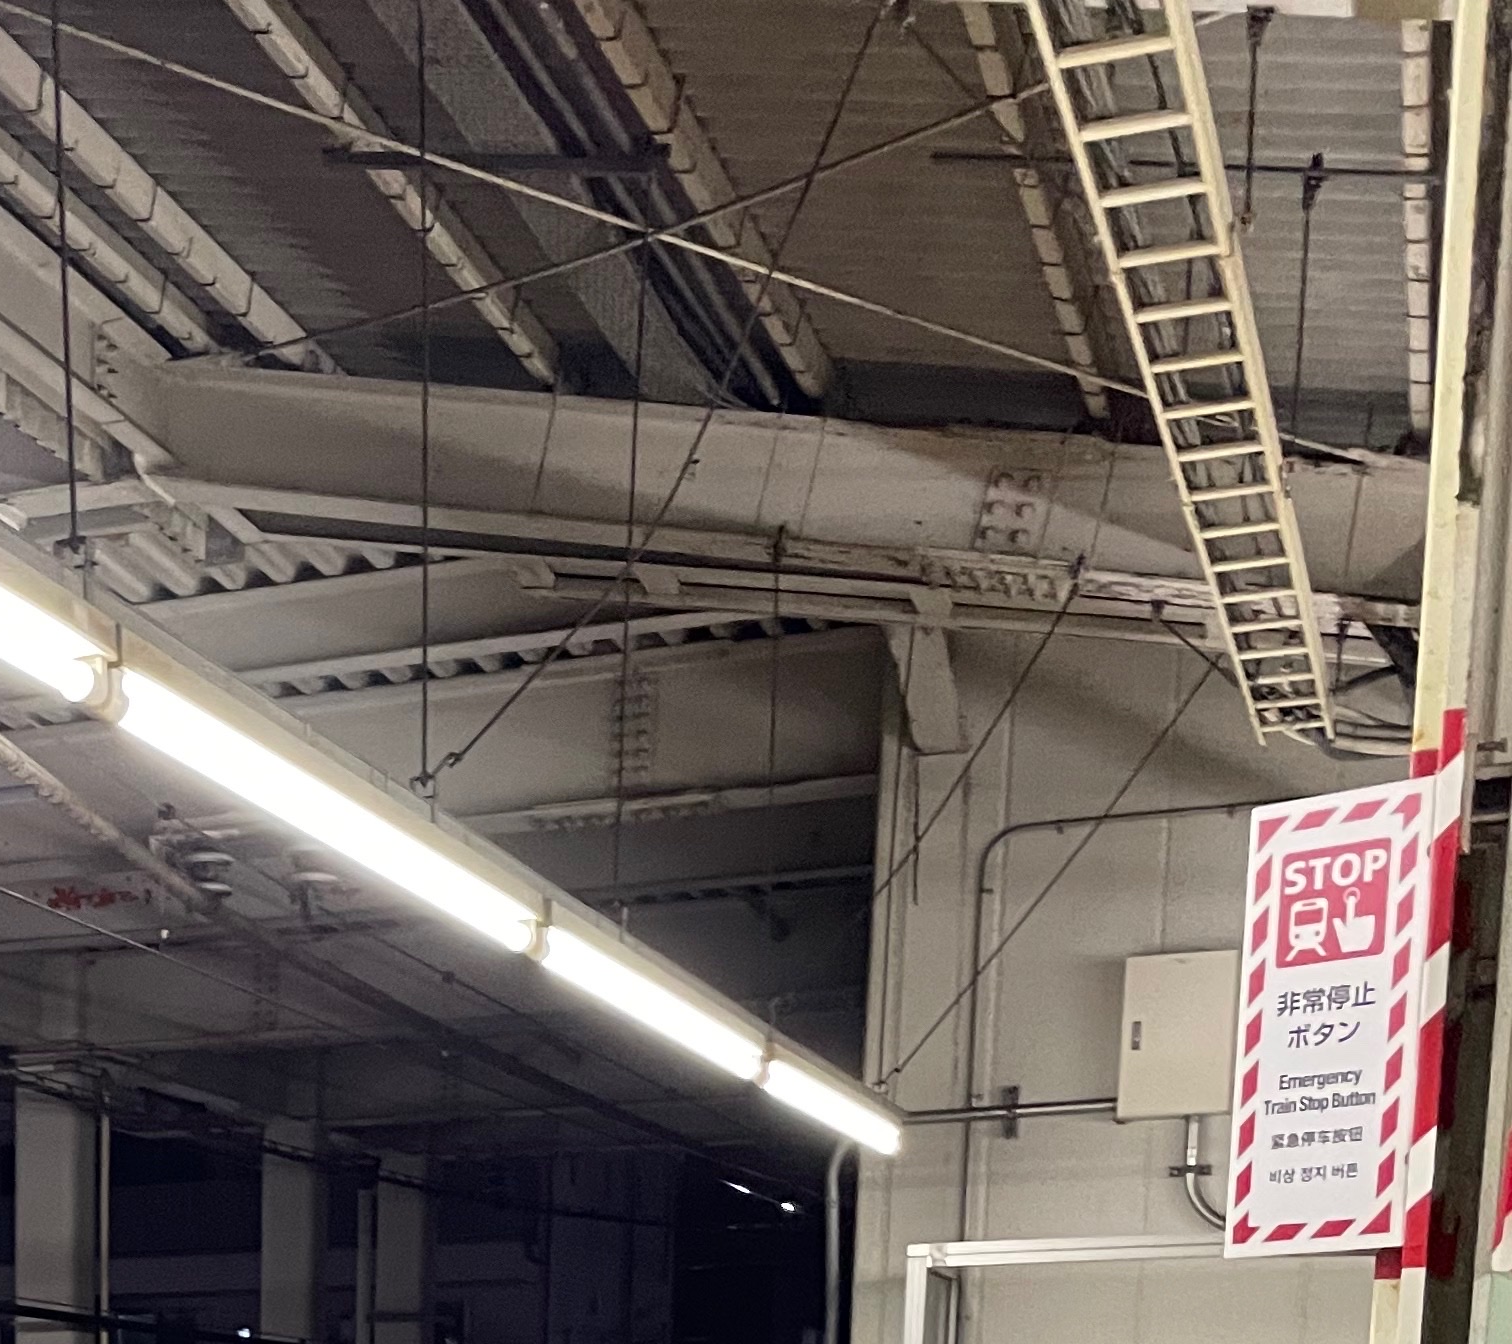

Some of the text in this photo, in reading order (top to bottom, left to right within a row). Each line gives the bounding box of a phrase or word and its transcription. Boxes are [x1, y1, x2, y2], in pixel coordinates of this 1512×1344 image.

[1284, 848, 1388, 895] STOP
[1277, 981, 1376, 1017] 非常停止
[1287, 1021, 1361, 1049] ボタン
[1279, 1069, 1363, 1090] Emergency
[1264, 1092, 1376, 1115] Train Stop Button
[1269, 1168, 1295, 1184] 비상
[1301, 1165, 1327, 1182] 정지
